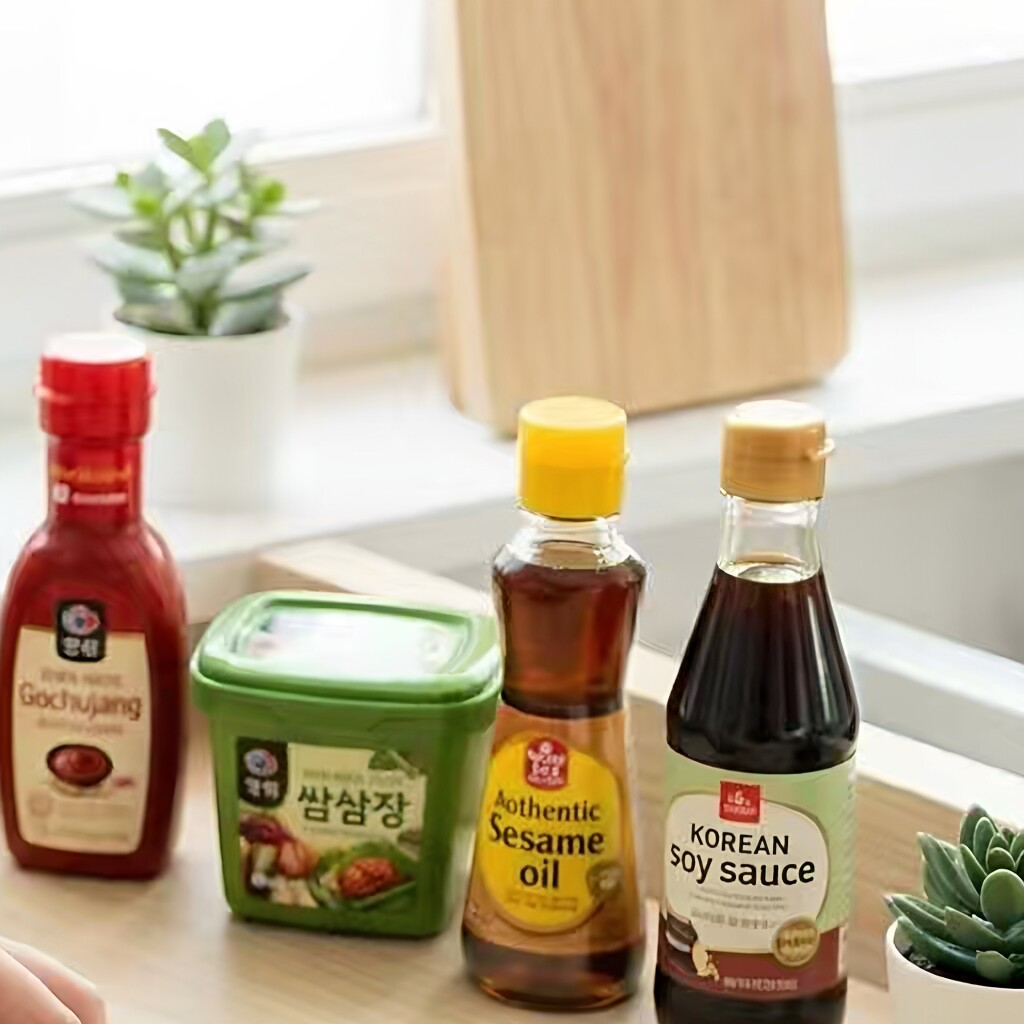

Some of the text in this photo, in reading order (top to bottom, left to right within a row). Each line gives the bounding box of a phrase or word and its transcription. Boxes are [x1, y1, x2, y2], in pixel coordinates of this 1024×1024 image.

[297, 785, 411, 830] 쌈삼장
[490, 811, 605, 855] Sesame
[690, 823, 789, 856] KOREAN
[519, 858, 560, 890] oil
[719, 860, 815, 887] sauce
